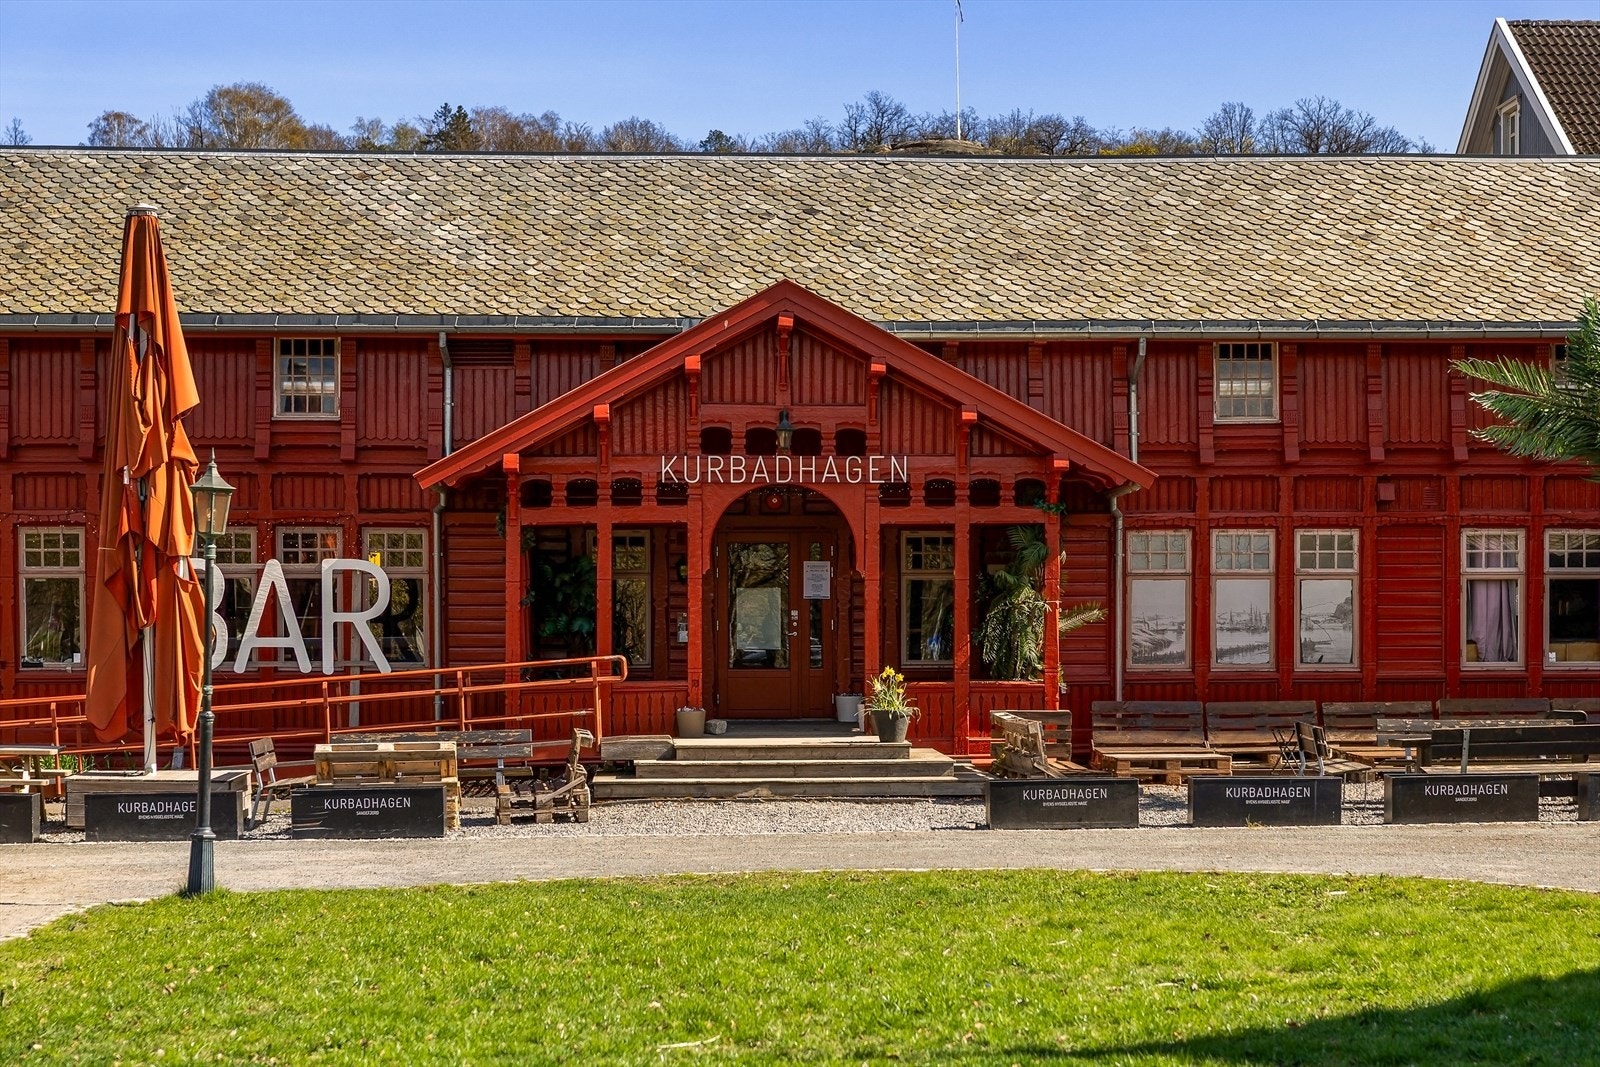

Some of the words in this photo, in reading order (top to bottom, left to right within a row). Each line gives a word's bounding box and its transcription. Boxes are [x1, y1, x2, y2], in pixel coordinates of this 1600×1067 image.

[660, 454, 909, 485] KURBADHAGEN
[1022, 788, 1108, 801] KURBADHAGEN
[1225, 786, 1311, 798] KURBADHAGEN
[1424, 782, 1508, 796] KURBADHAGEN
[117, 801, 197, 814] KURBADHAGE
[324, 797, 411, 810] KURBADHAGEN
